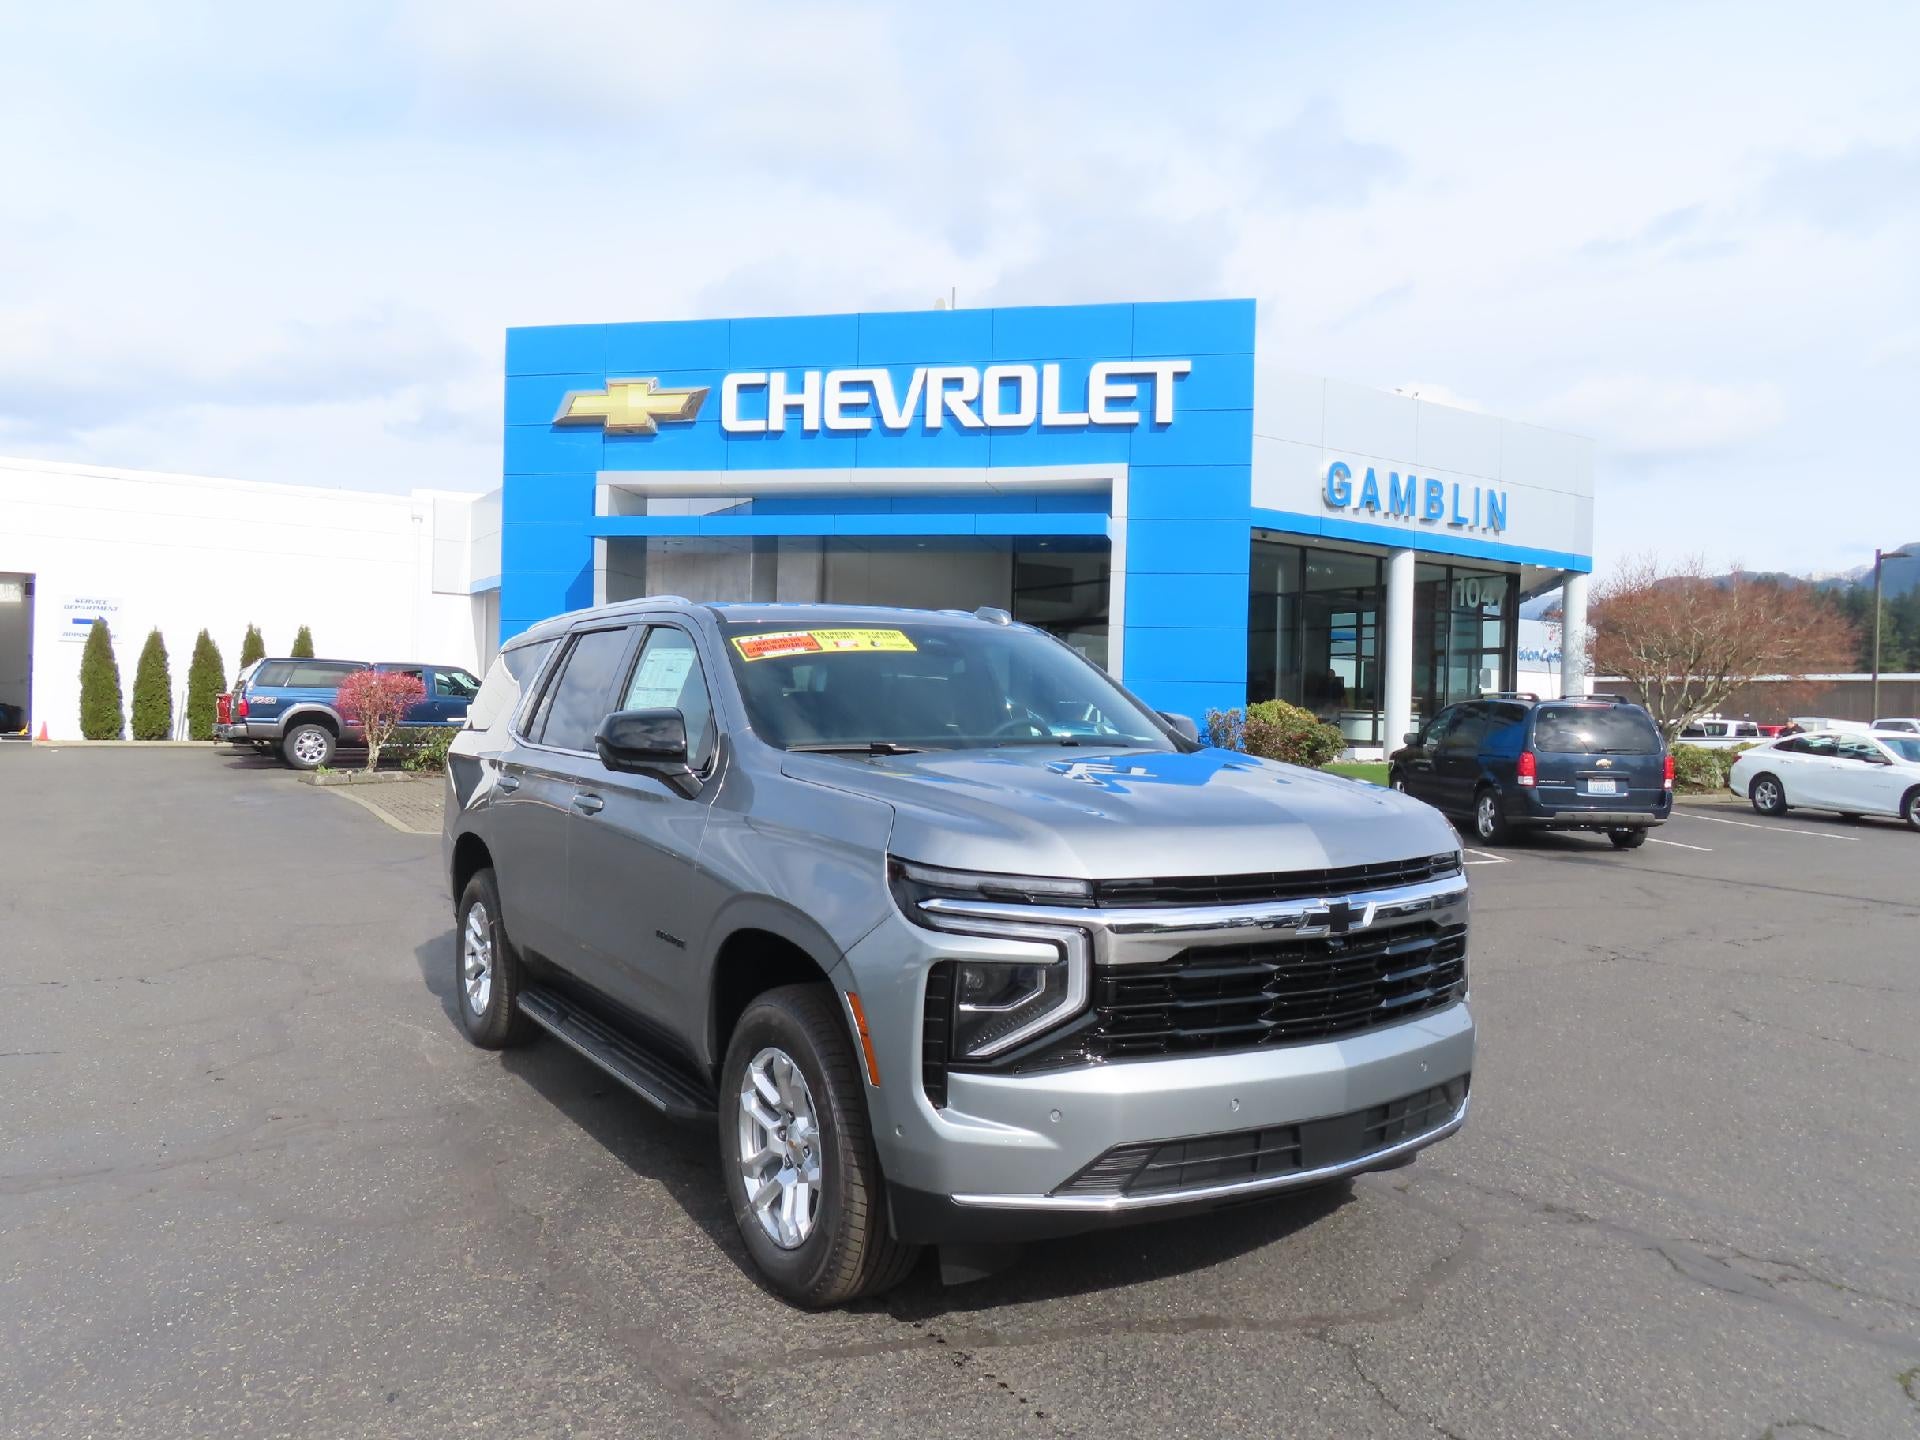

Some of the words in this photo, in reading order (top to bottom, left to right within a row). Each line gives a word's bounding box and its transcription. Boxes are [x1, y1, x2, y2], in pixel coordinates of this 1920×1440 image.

[721, 360, 1192, 432] CHEVROLET
[1325, 461, 1507, 531] GAMBLIN
[1456, 576, 1509, 610] 1047
